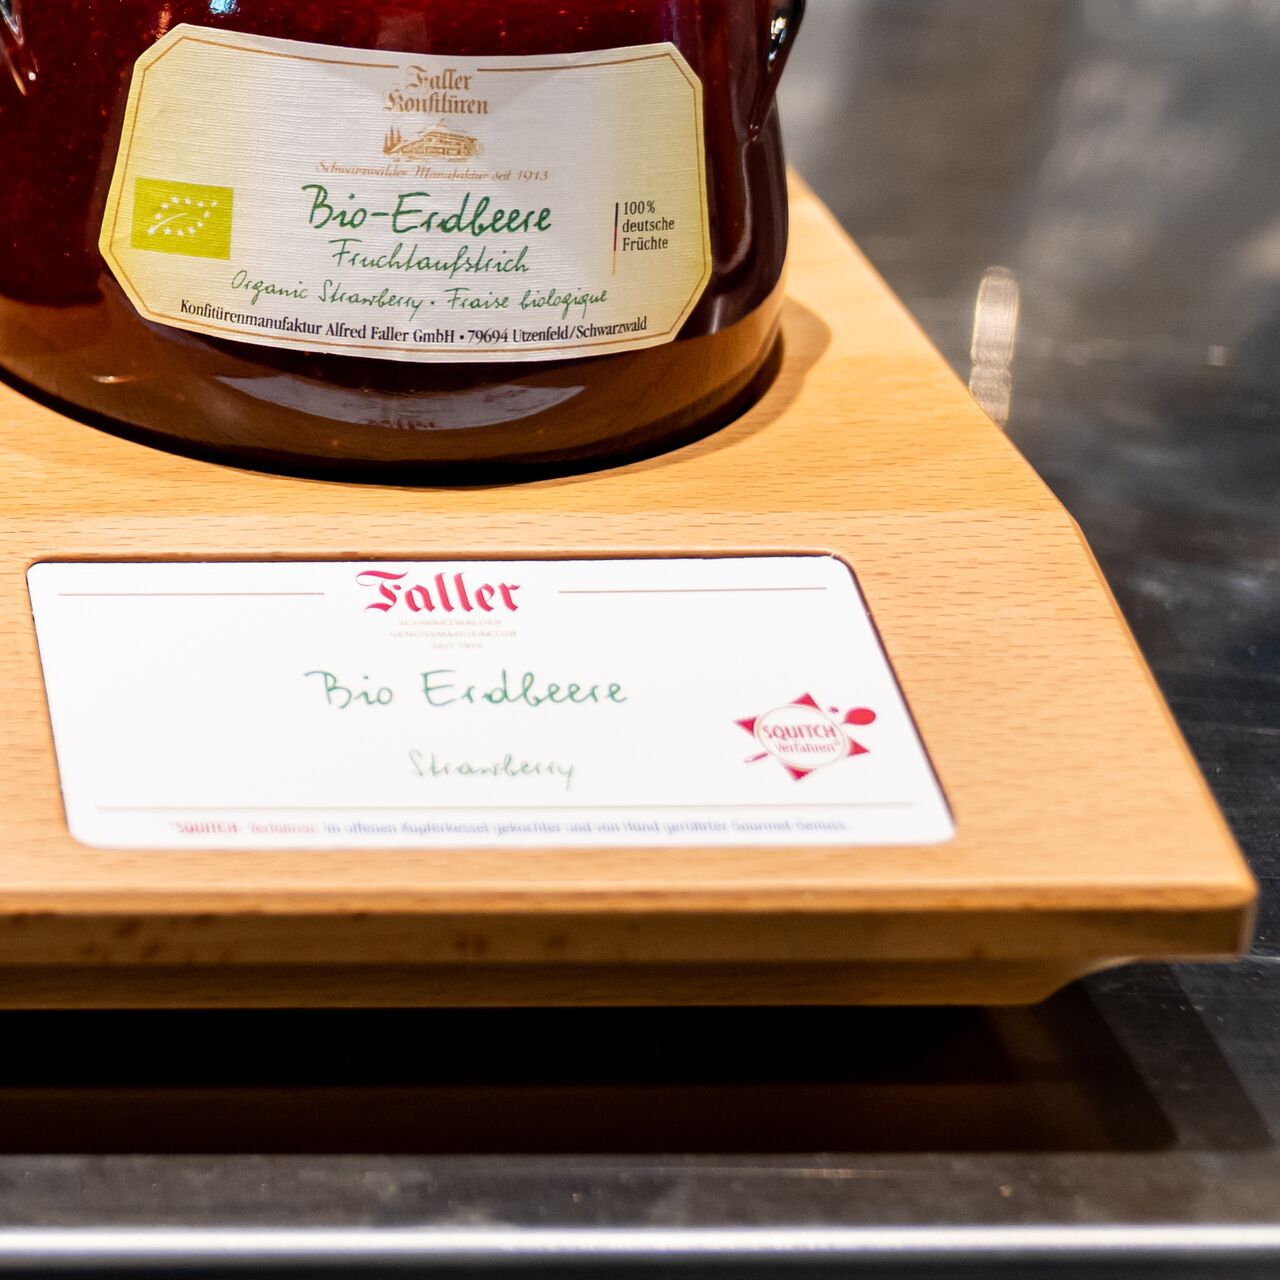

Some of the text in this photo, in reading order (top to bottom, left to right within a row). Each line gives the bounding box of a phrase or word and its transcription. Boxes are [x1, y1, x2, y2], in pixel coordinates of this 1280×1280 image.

[406, 65, 473, 91] Faller
[383, 88, 489, 116] Konfitüren
[301, 183, 553, 236] Bio-Erdbeere
[623, 200, 657, 216] 100%
[622, 217, 676, 234] deutsche
[329, 238, 530, 279] Fruchtaufstrich
[622, 235, 670, 253] Früchte
[231, 270, 608, 322] Organic Strawberry Fraise biologique
[180, 298, 648, 345] Konfitürenmanufaktur Alfred Faller GmbH 79694 Utzenfeld/Schwarzwald
[355, 570, 521, 612] Faller
[304, 668, 627, 709] Bio Erdbeere
[762, 724, 837, 741] SQUITCH
[775, 741, 835, 754] Verfahren
[408, 748, 575, 792] Strawberry
